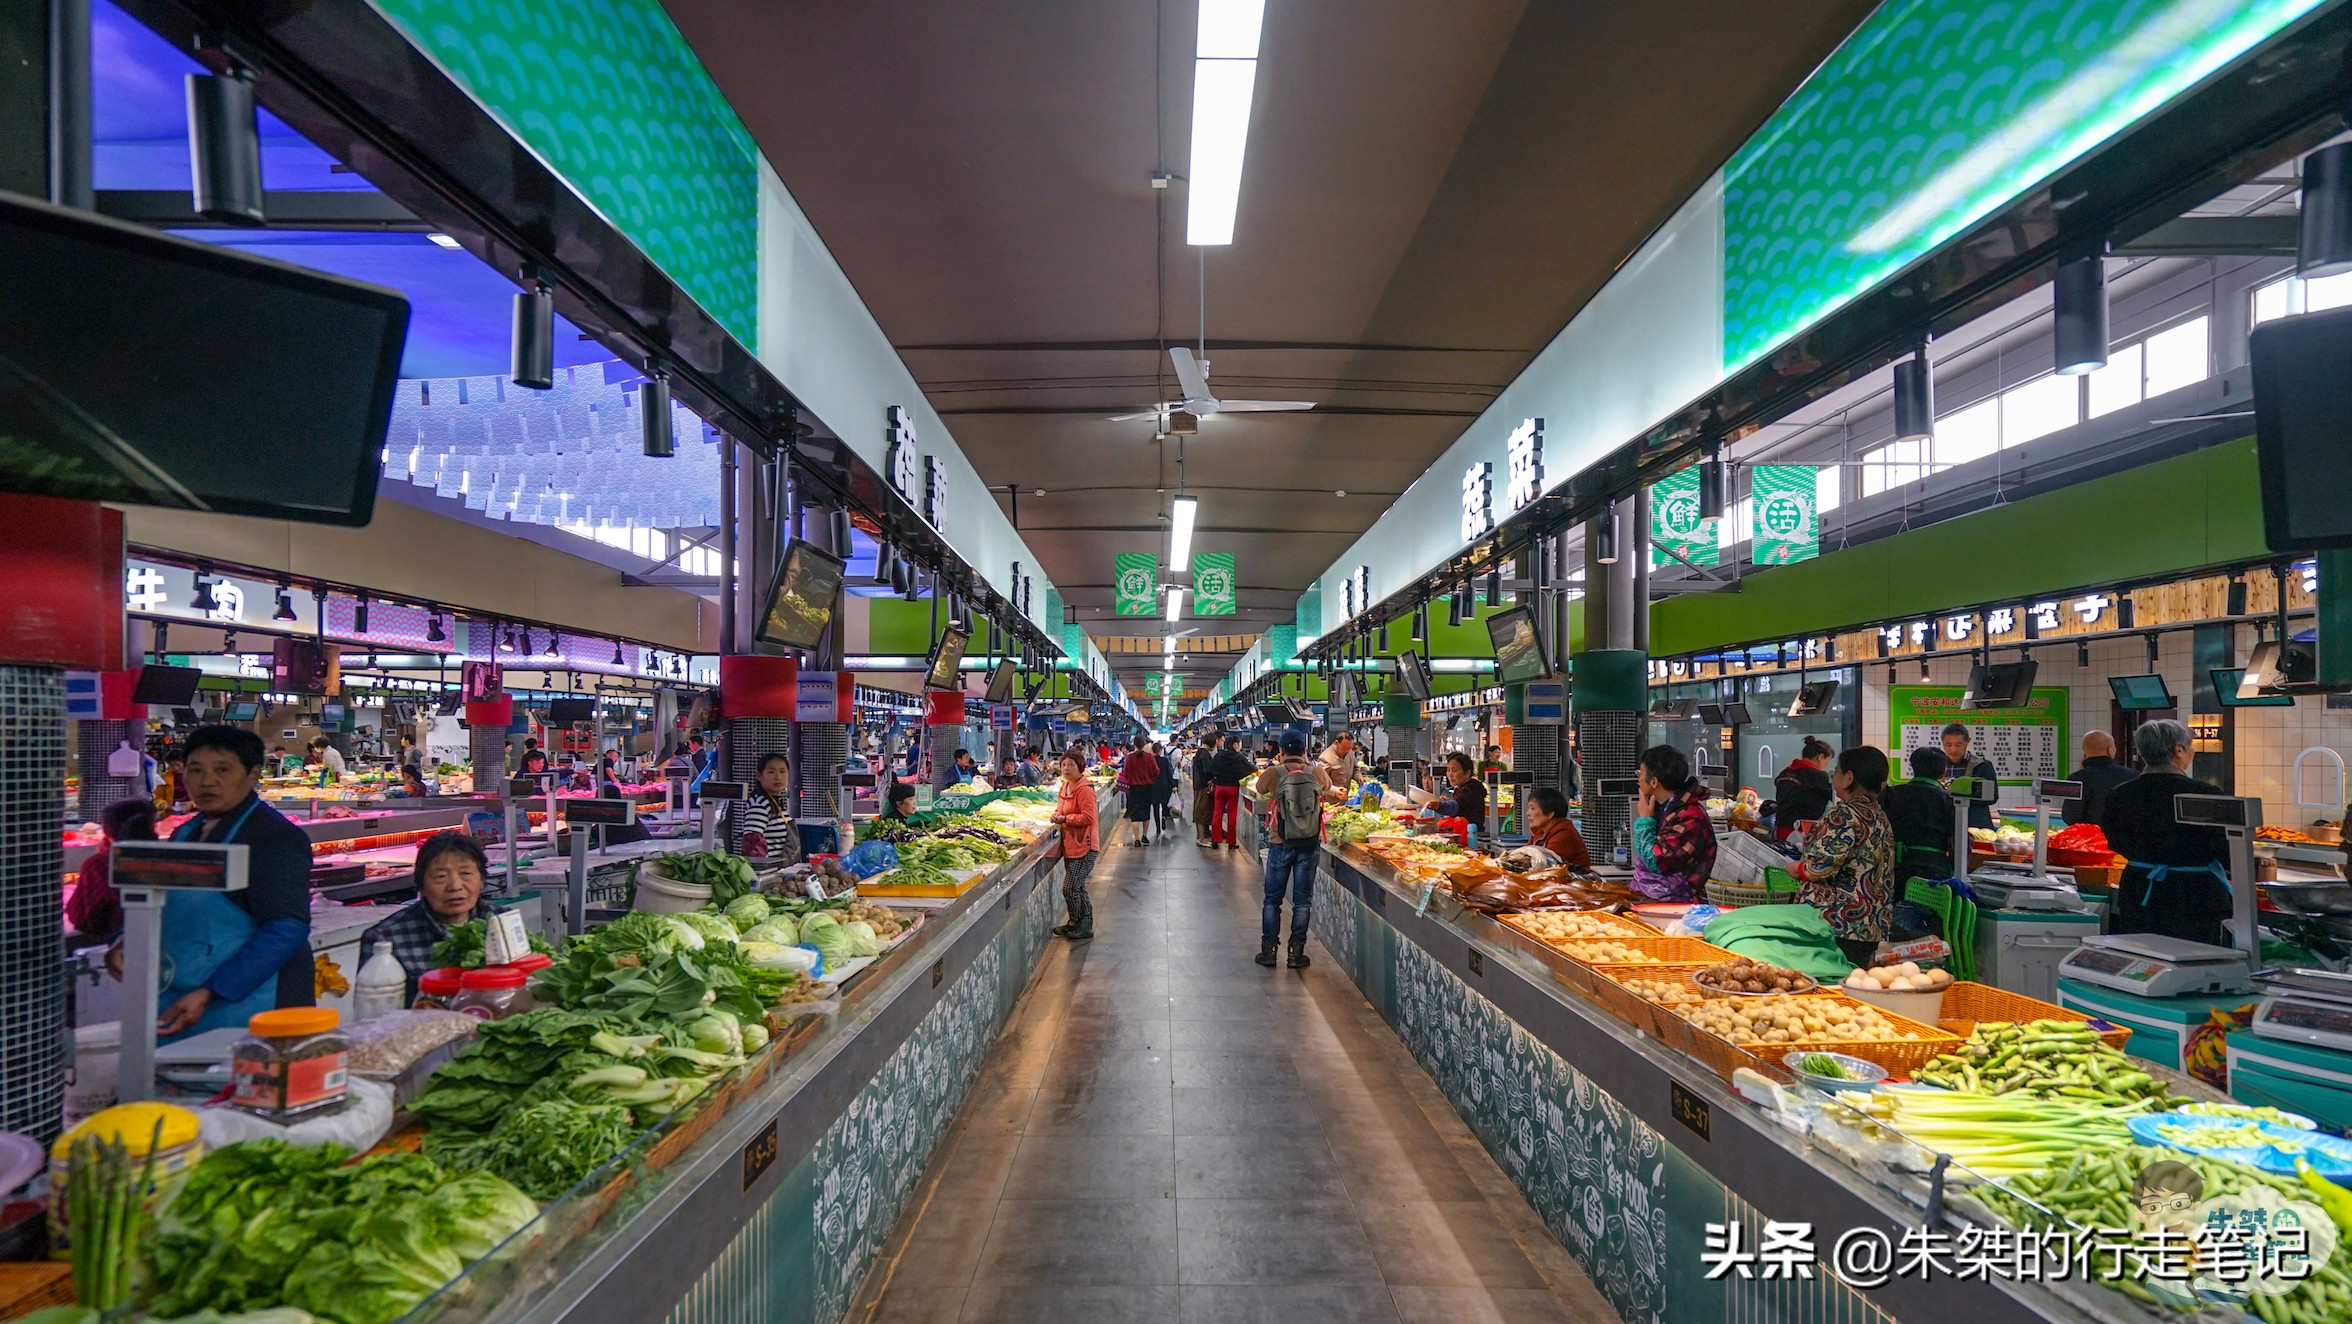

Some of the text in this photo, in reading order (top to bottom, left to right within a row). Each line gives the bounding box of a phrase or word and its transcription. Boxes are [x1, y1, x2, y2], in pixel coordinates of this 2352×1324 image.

[1461, 417, 1545, 541] 蔬菜
[1768, 501, 1798, 530] 活
[1204, 576, 1223, 593] 活
[2030, 697, 2049, 708] 公司
[1683, 1098, 1708, 1132] S-37
[1625, 1169, 1650, 1222] FOODS
[1565, 1212, 1596, 1260] MARKET
